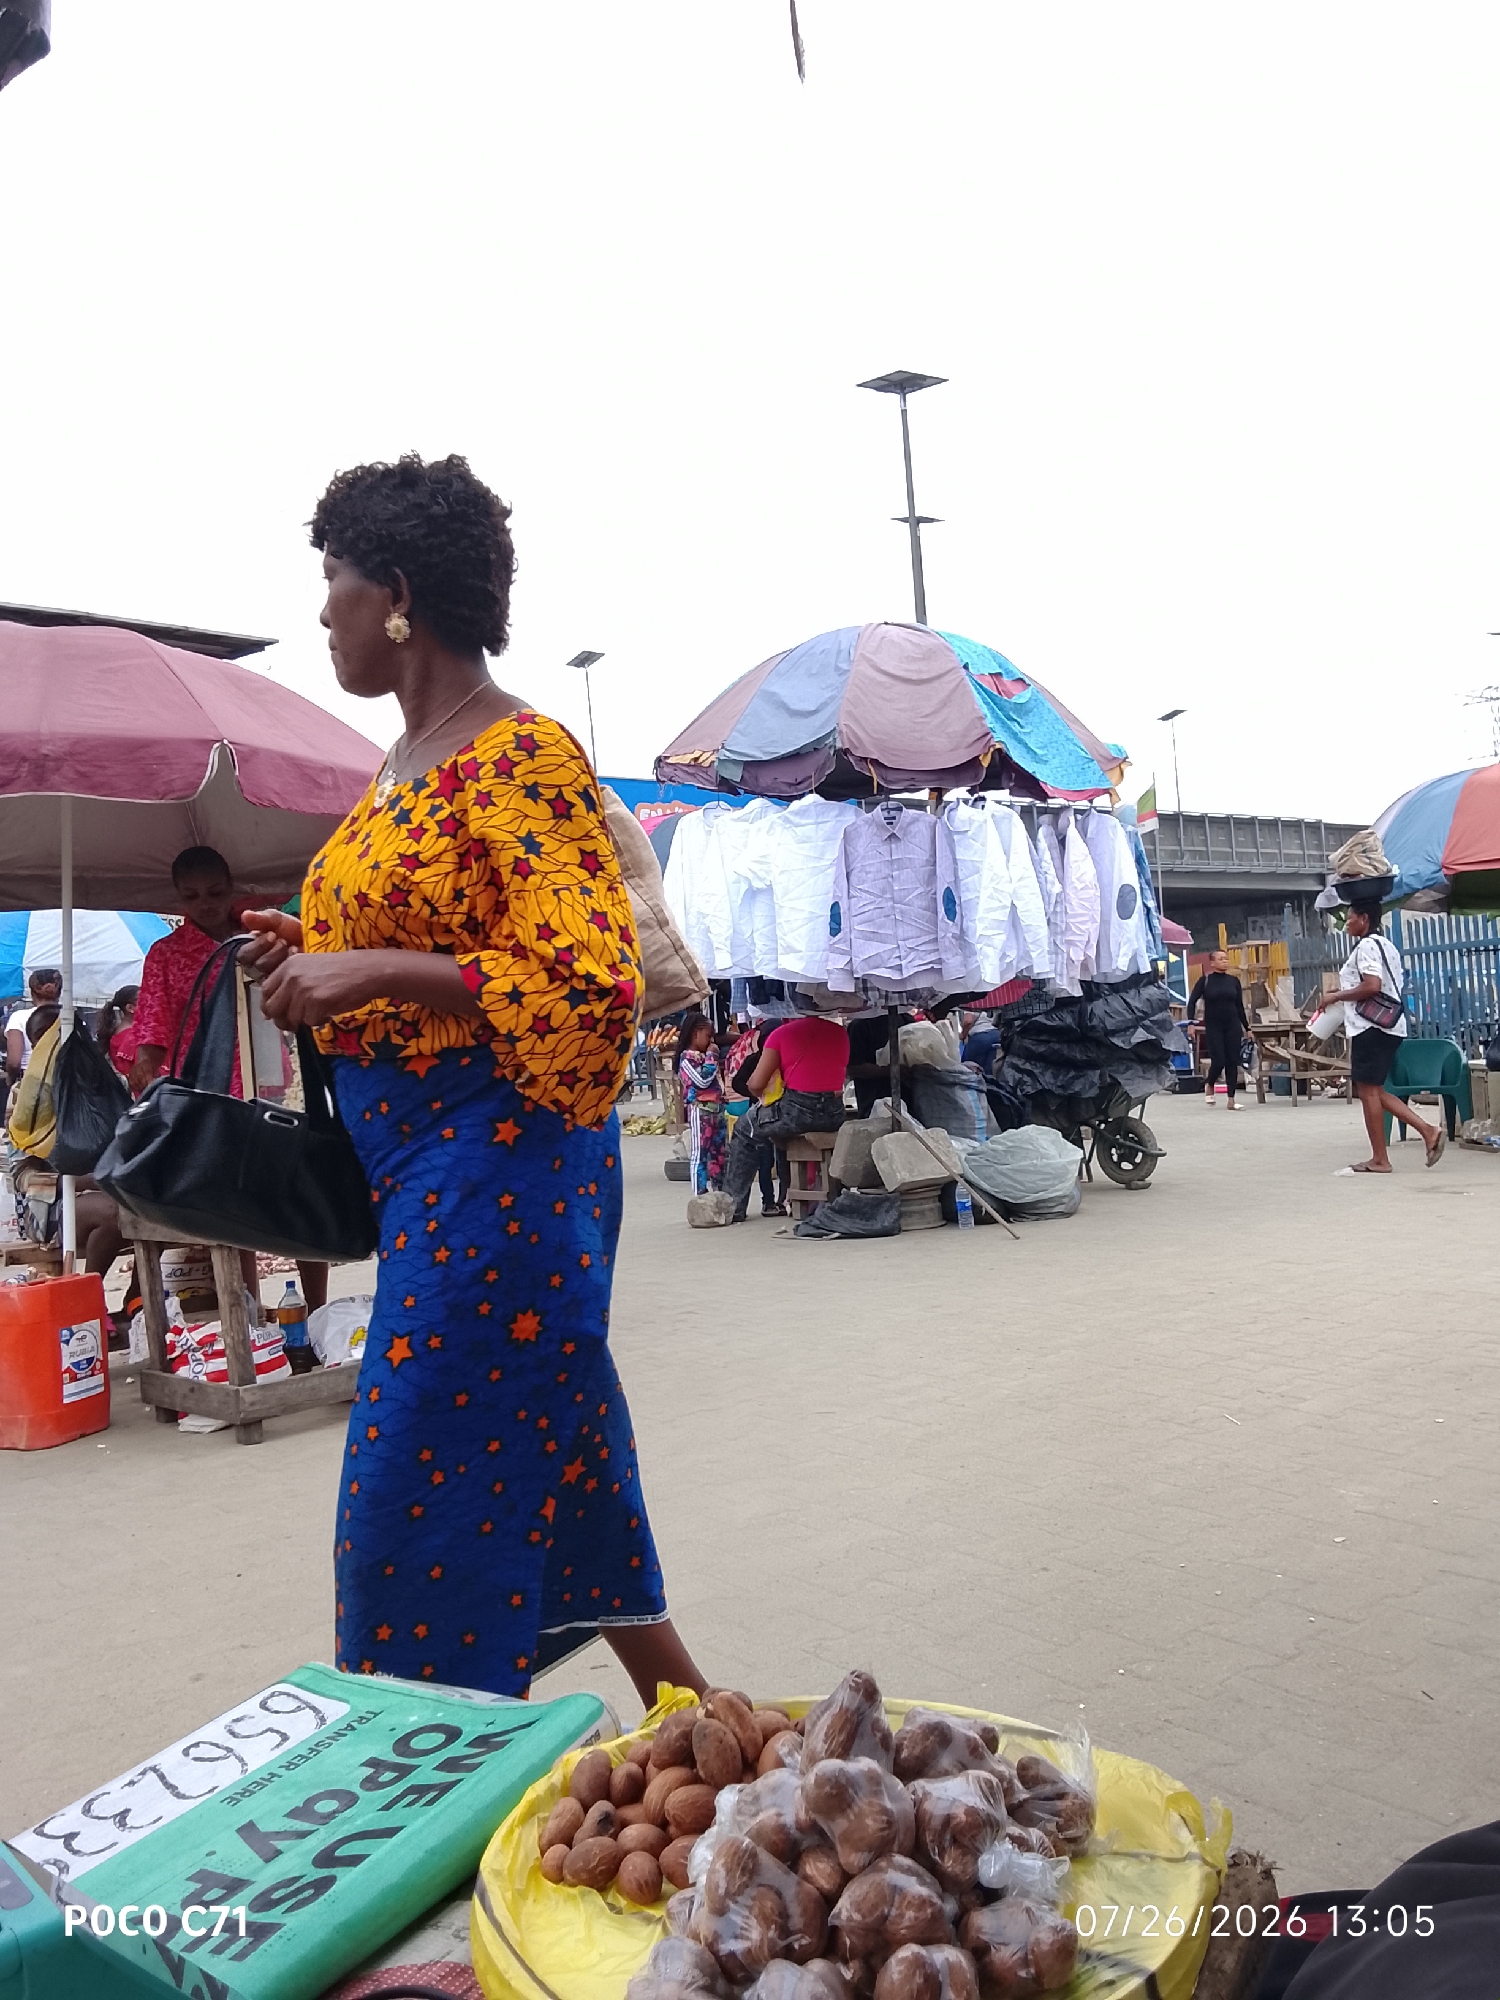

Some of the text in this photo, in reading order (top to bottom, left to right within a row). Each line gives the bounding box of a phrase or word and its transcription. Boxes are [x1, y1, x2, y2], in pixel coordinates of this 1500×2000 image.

[220, 1710, 384, 1807] TRANSFER HERE
[235, 1723, 463, 1863] OPay
[180, 1716, 542, 1962] WE USE
